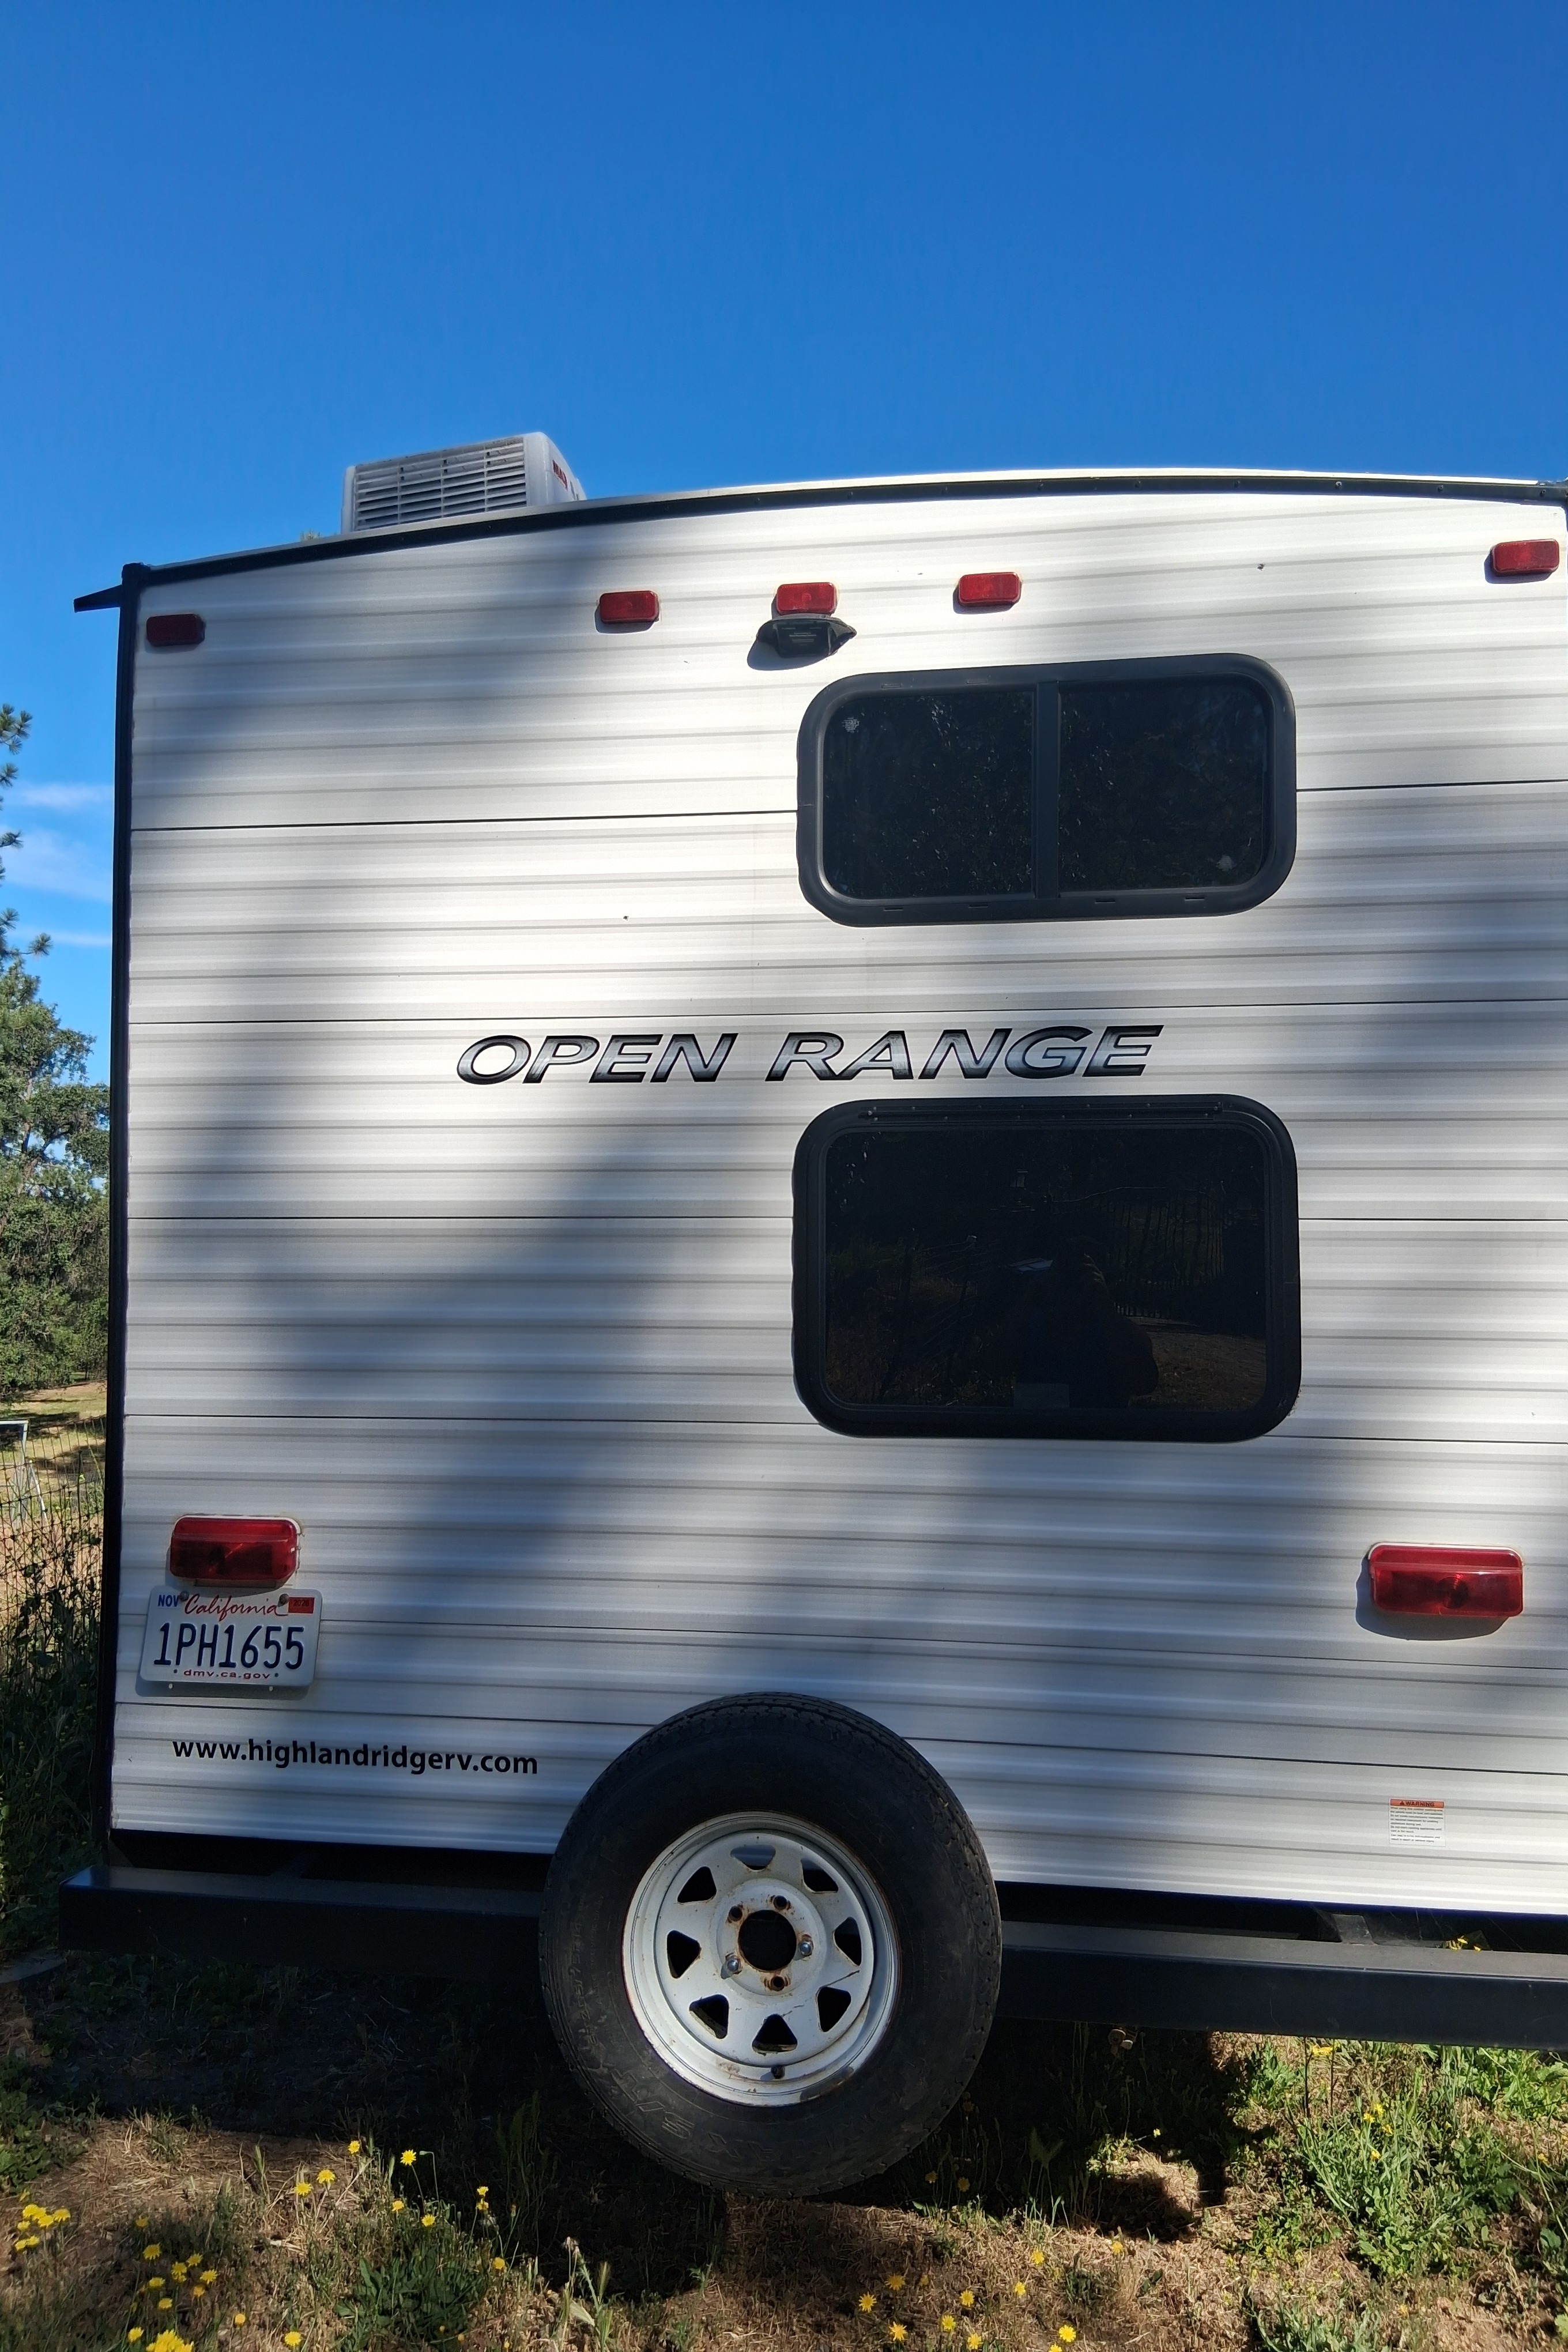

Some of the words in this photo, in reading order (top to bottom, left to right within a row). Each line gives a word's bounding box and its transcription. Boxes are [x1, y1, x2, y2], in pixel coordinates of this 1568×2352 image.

[457, 1032, 738, 1085] OPEN
[765, 1025, 1164, 1081] RANGE
[158, 1595, 179, 1607] NOV
[184, 1593, 288, 1622] California
[154, 1622, 304, 1669] 1PH1655
[183, 1669, 270, 1680] dmv.ca.gov
[172, 1739, 538, 1775] www.highlandridgerv.com
